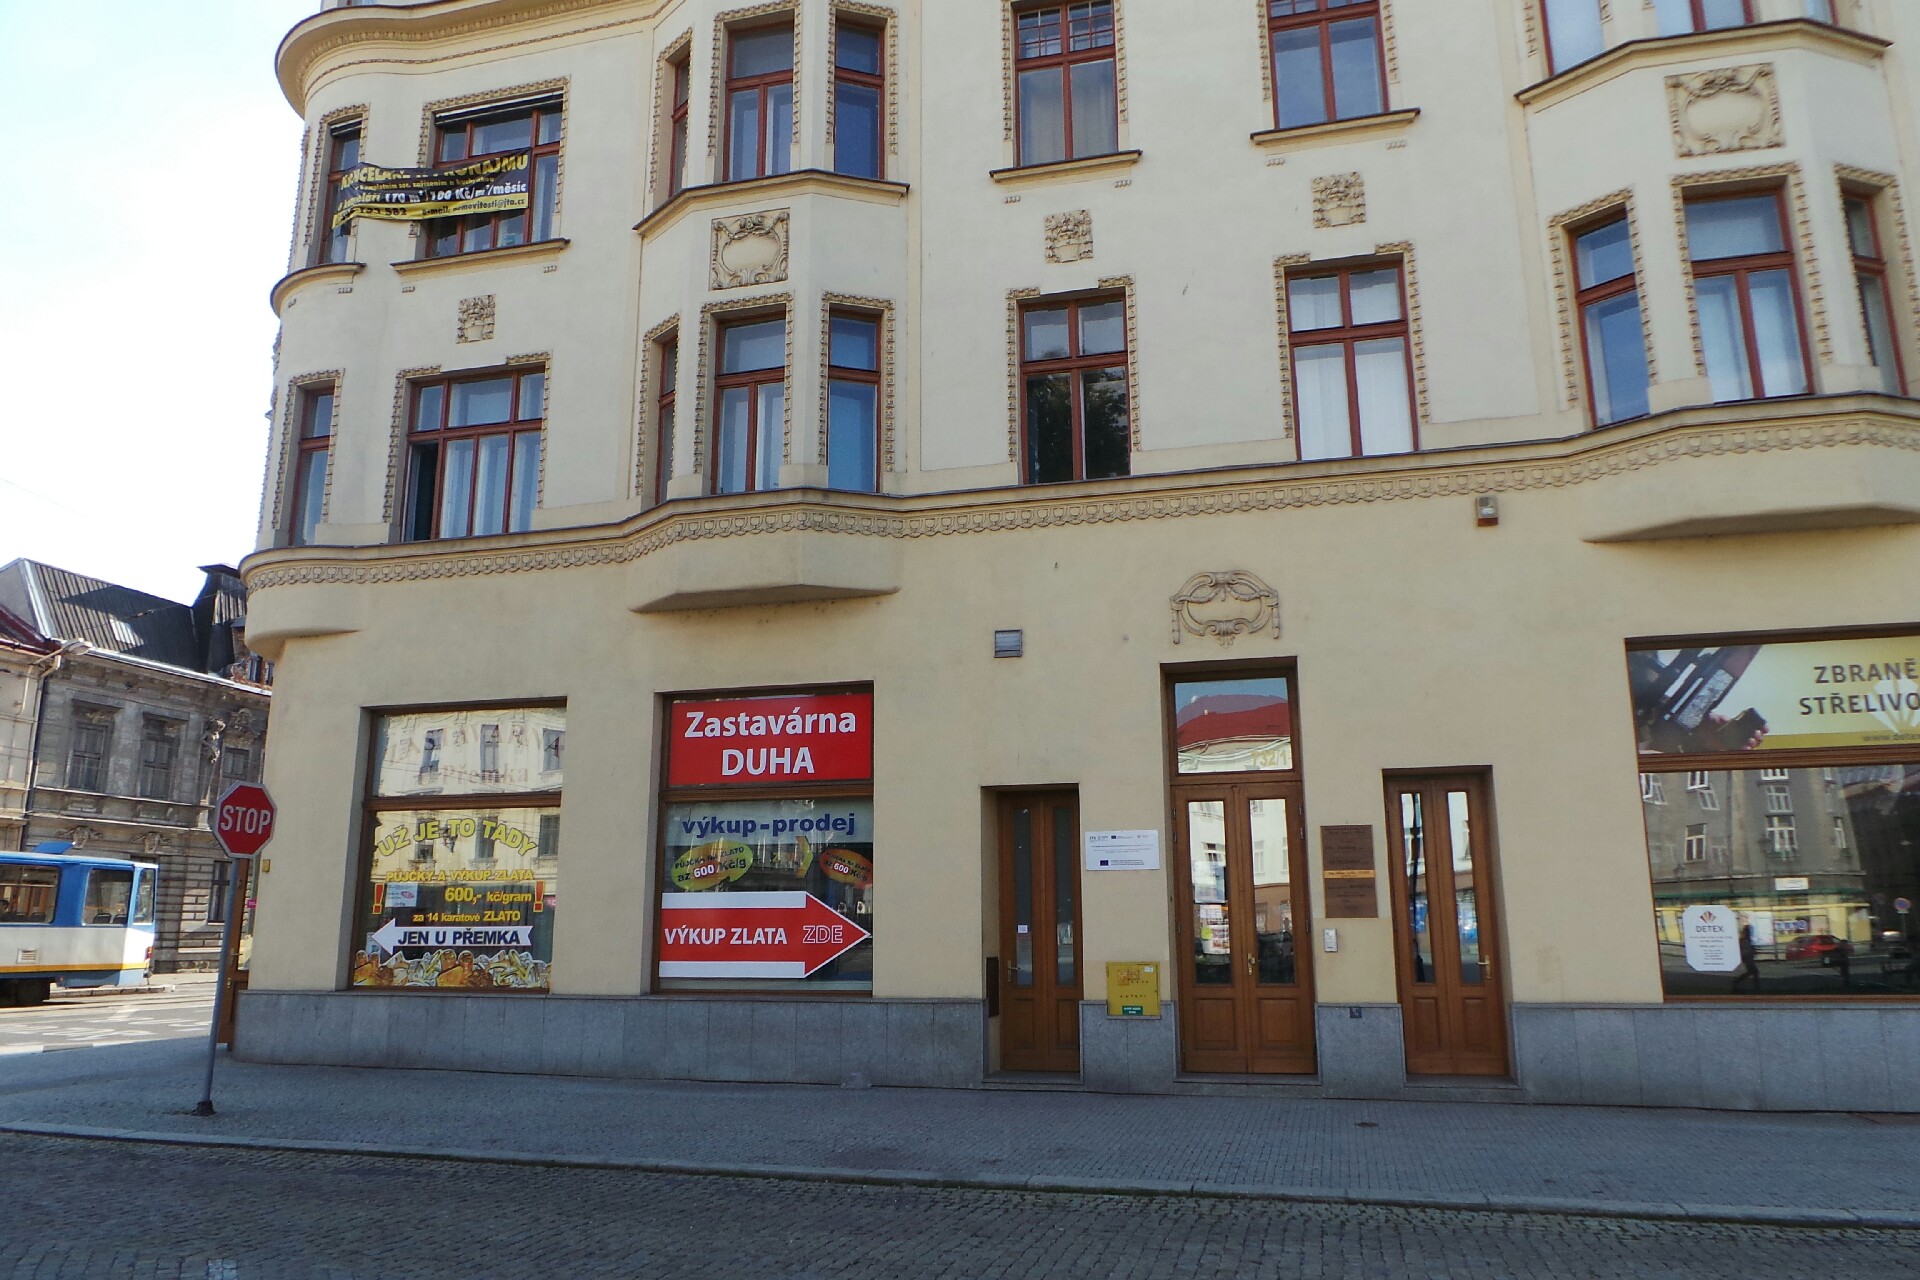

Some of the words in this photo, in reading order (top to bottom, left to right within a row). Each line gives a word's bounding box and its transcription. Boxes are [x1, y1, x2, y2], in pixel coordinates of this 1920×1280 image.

[385, 207, 407, 216] 582
[1813, 657, 1920, 684] ZBRANĚ
[684, 707, 856, 738] Zastavárna
[721, 746, 815, 776] DUHA
[220, 804, 271, 835] STOP
[377, 823, 411, 857] UŽ
[413, 820, 441, 842] JE
[448, 818, 476, 838] TO
[482, 820, 538, 857] TADY
[385, 868, 435, 882] PŮJČKY
[436, 870, 446, 881] A
[450, 867, 491, 881] VÝKUP
[495, 869, 534, 881] ZLATA
[693, 864, 715, 878] 600
[833, 862, 849, 874] 600
[413, 914, 424, 922] za
[427, 912, 438, 922] 14
[441, 912, 480, 922] karatové
[483, 910, 521, 922] ZLATO
[397, 931, 429, 945] JEN
[434, 931, 447, 945] U
[452, 927, 521, 945] PŘEMKA
[664, 924, 726, 945] VÝKUP
[730, 927, 788, 945] ZLATA
[802, 924, 843, 944] ZDE
[1695, 925, 1725, 933] DETEX
